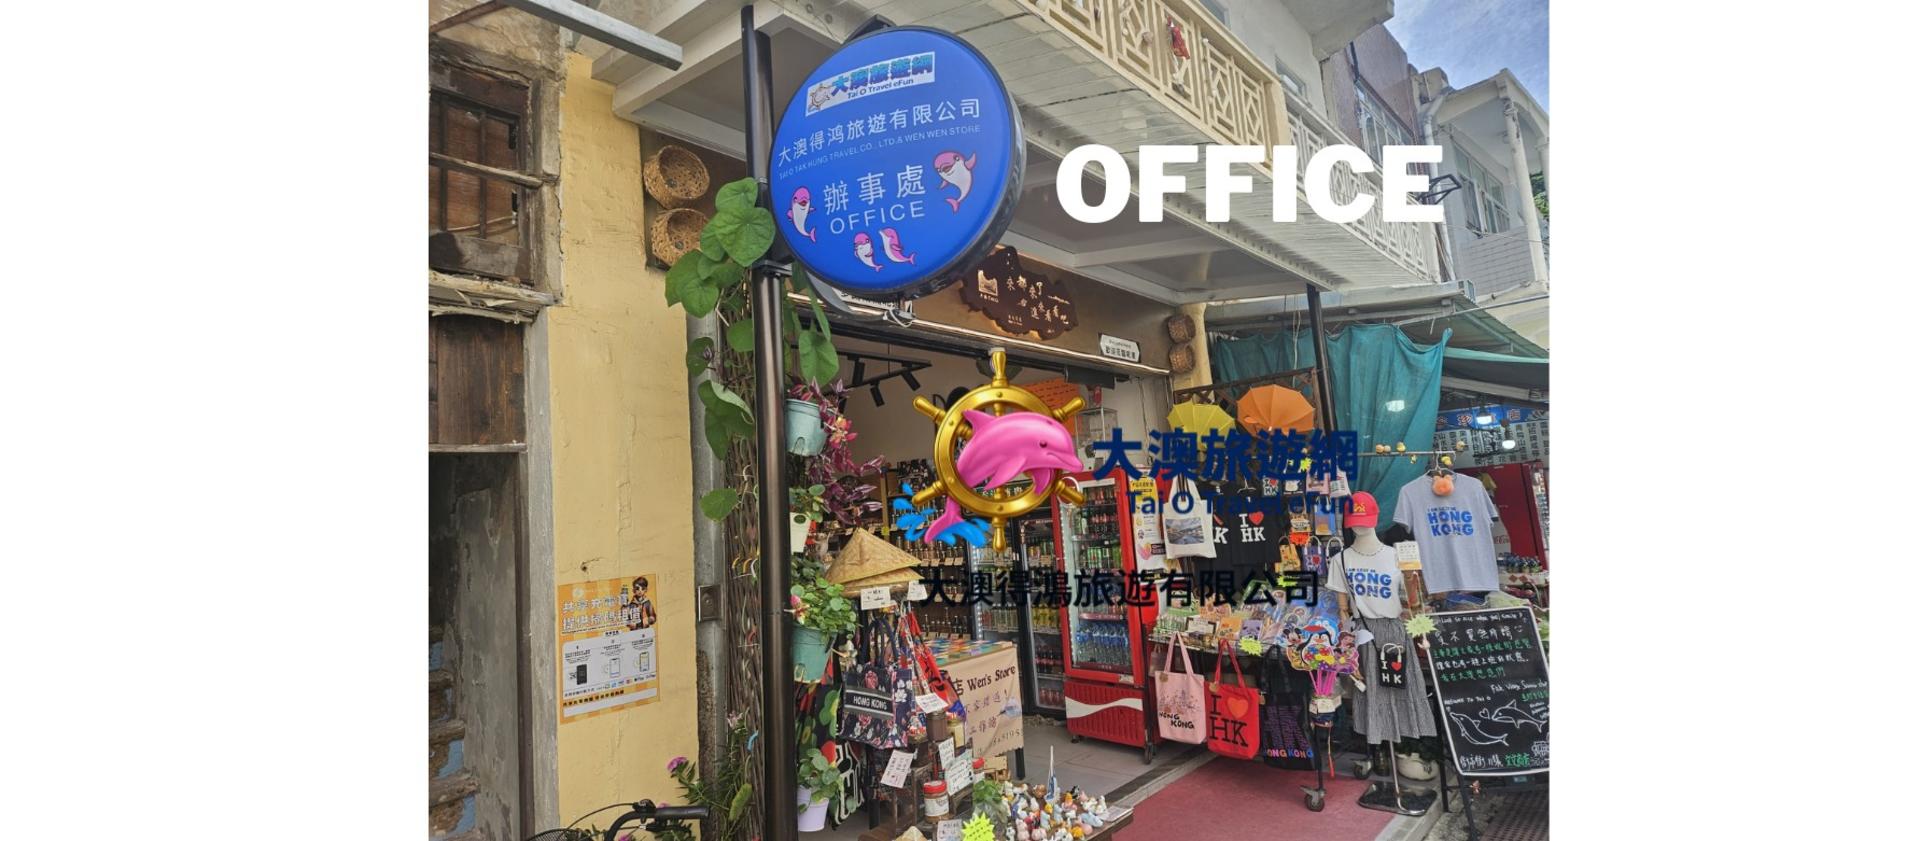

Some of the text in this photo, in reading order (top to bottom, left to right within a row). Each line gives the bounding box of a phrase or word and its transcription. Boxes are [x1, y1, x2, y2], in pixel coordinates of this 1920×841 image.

[847, 78, 914, 99] Tai O Travel eFun
[807, 155, 829, 169] HUNG
[829, 146, 859, 160] TRAVEL
[904, 131, 925, 143] WEN
[926, 128, 948, 139] WEN
[948, 123, 981, 136] STORE
[823, 165, 926, 215] 辦事處
[830, 200, 925, 234] OFFICE
[1427, 511, 1473, 524] HONG
[1242, 527, 1266, 543] HK
[1431, 523, 1474, 537] KONG
[1346, 572, 1392, 586] HONG
[1381, 660, 1388, 670] I
[966, 665, 1016, 692] Wen's Store
[1210, 694, 1222, 716] I
[1158, 711, 1181, 720] HONG
[1170, 719, 1196, 730] KONG
[1209, 715, 1249, 747] HK
[1288, 747, 1313, 759] KONG
